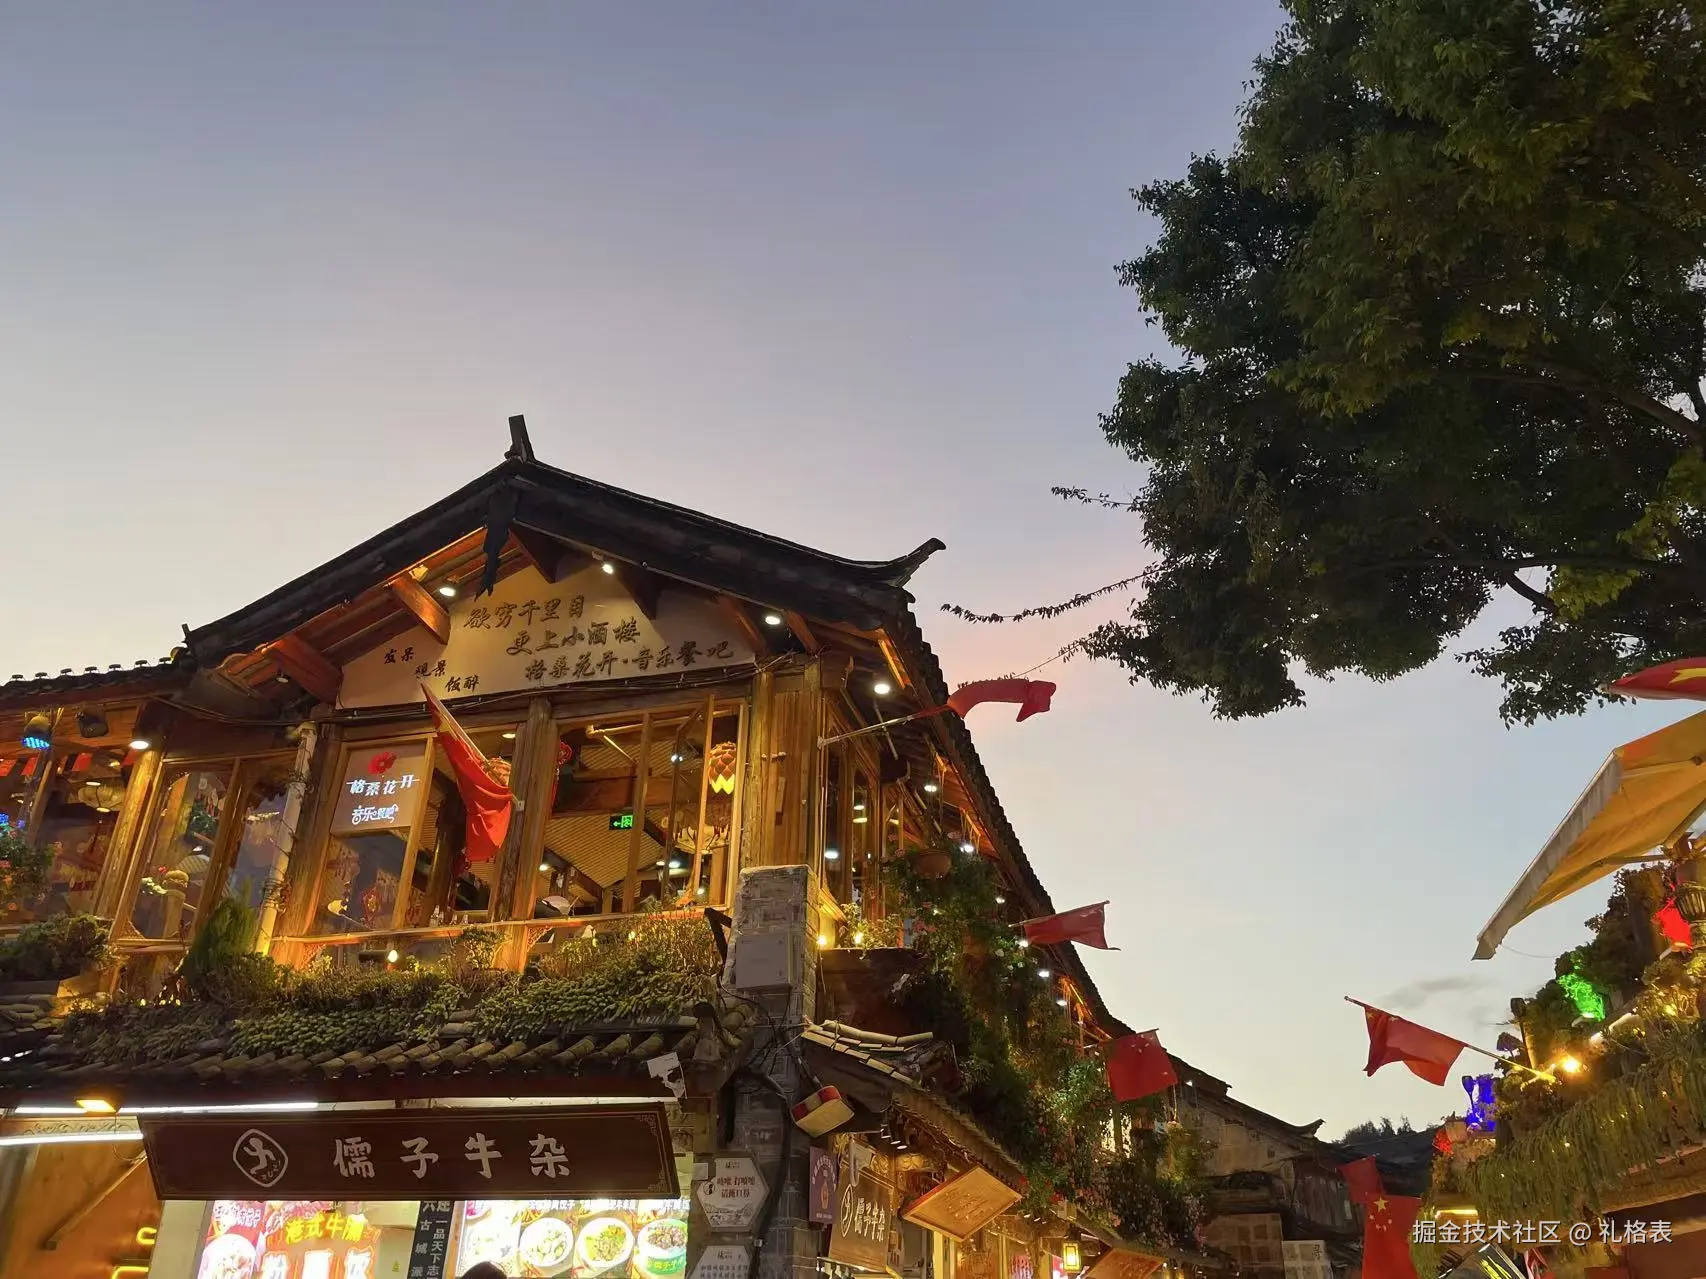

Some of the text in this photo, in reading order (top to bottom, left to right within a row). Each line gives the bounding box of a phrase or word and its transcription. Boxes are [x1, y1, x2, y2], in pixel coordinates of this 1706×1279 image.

[464, 595, 585, 629] 欲穷千里目
[507, 615, 641, 655] 更上小酒楼
[414, 660, 447, 679] 观景
[445, 674, 480, 692] 饭醉
[332, 1132, 571, 1179] 儒子牛杂
